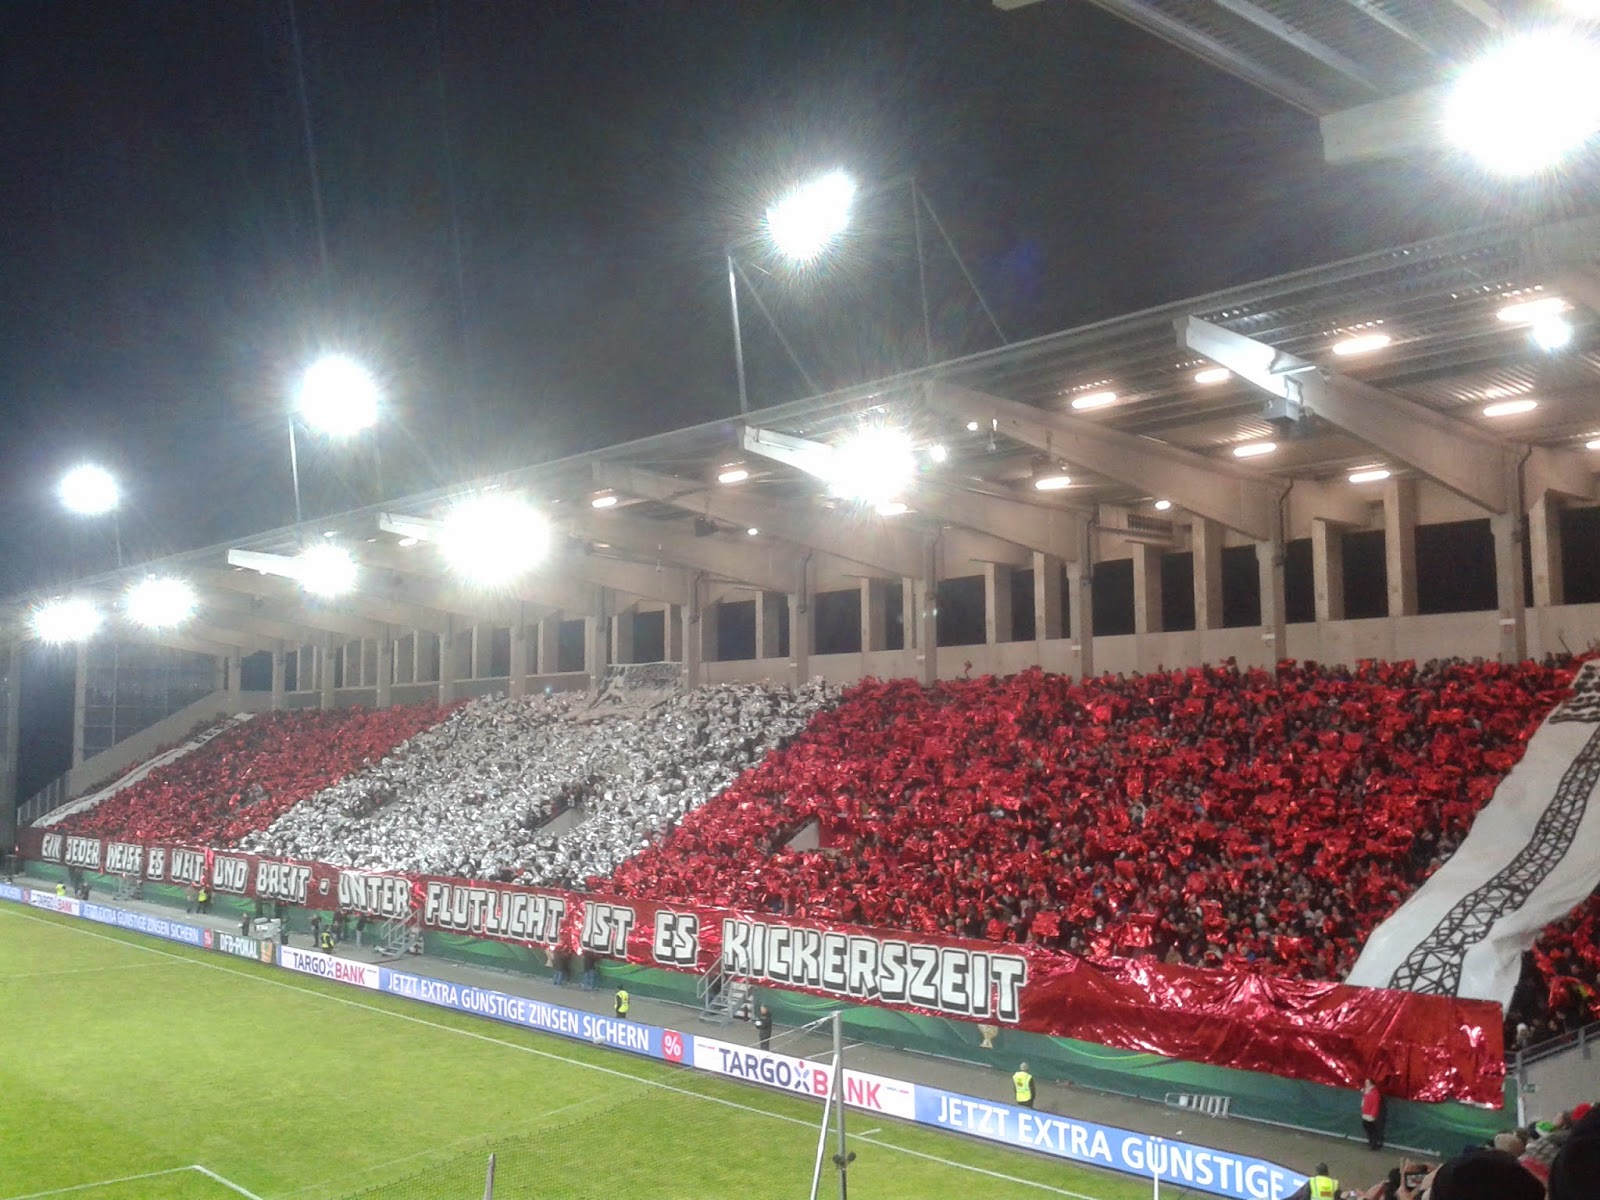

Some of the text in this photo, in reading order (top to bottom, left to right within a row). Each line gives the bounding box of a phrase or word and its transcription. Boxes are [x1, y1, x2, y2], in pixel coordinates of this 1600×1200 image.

[42, 833, 62, 862] EIN
[65, 836, 100, 870] JEDER
[106, 842, 143, 876] WEISS
[147, 847, 165, 880] ES
[171, 848, 206, 885] WEIT
[212, 856, 249, 894] UND
[256, 861, 312, 903] BREIT
[338, 871, 411, 918] UNTER
[425, 882, 565, 945] FLUTLICHT
[581, 901, 634, 958] IST
[653, 910, 699, 967] ES
[722, 918, 1028, 1022] KICKERSZEIT
[171, 923, 198, 942] SICHERN
[220, 934, 258, 959] DFB-POKAL
[388, 972, 649, 1051] JETZT EXTRA GÜNSTIGE ZINSEN SICHERN
[937, 1094, 1285, 1200] JETZT EXTRA GÜNSTIGE
